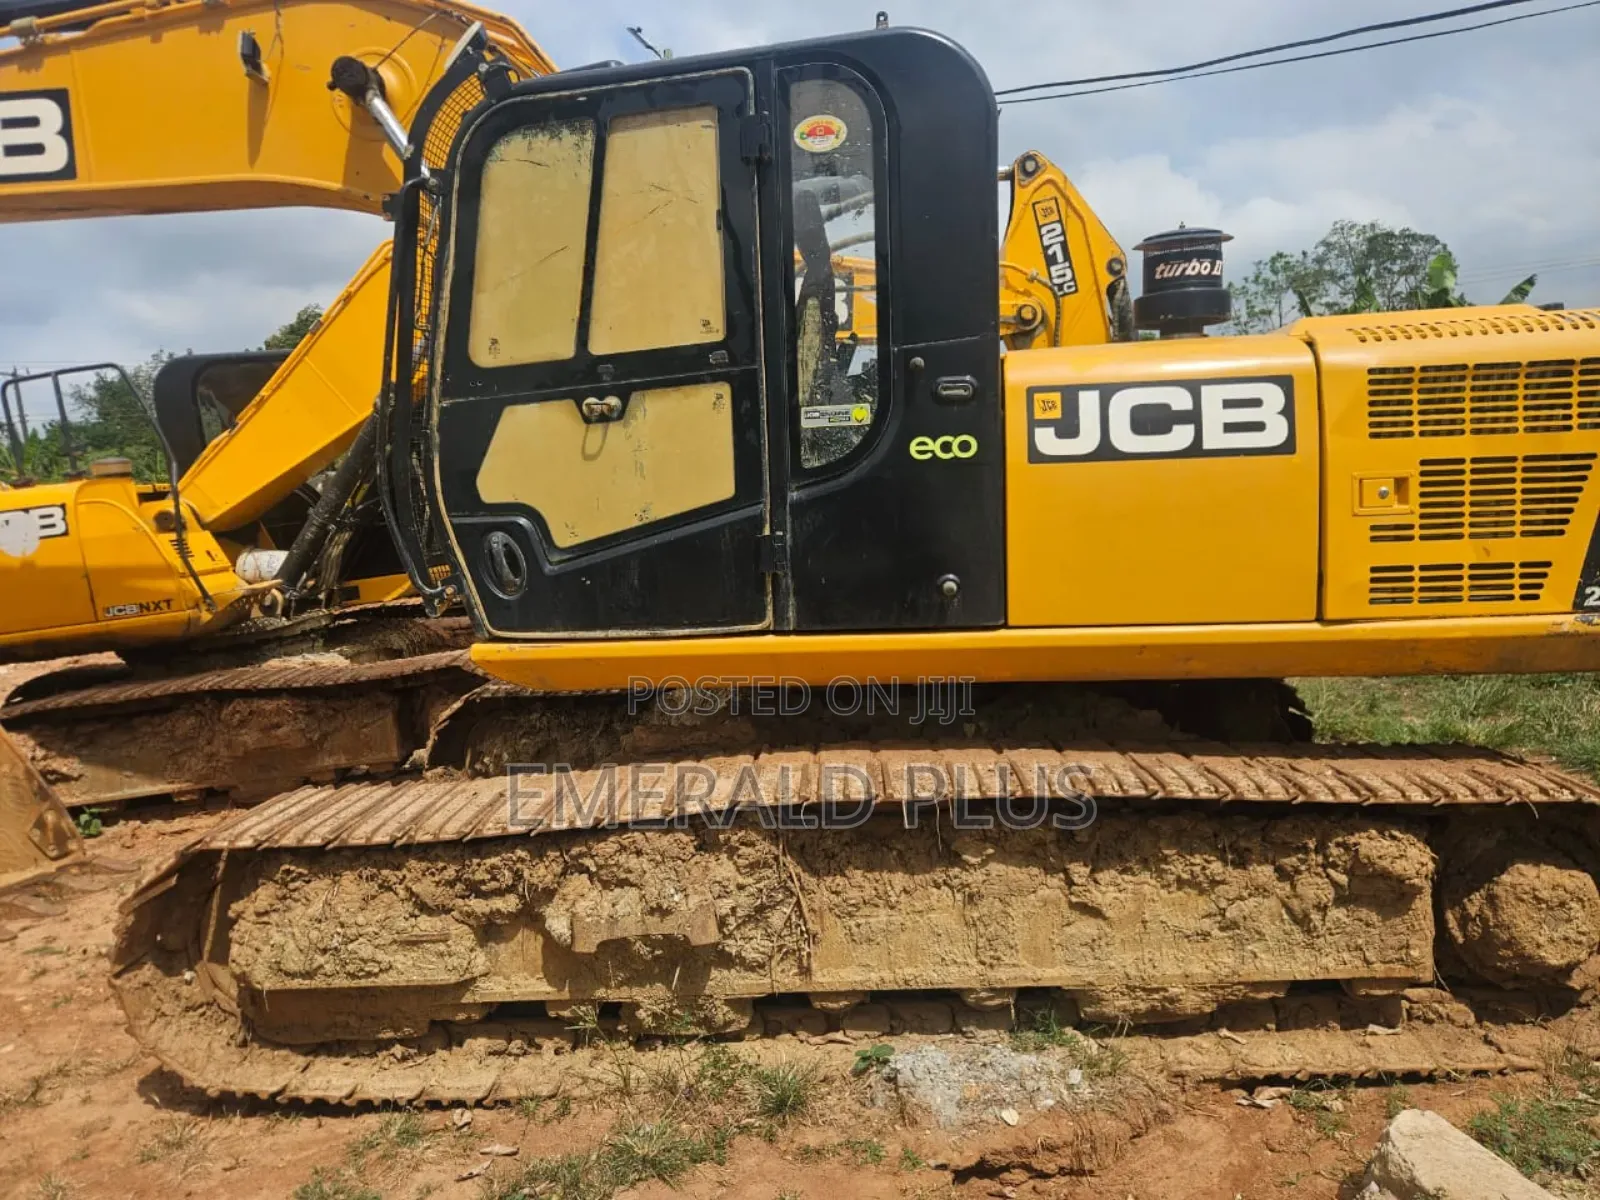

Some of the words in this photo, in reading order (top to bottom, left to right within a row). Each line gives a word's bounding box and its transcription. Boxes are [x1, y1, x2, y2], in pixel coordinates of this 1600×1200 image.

[1155, 258, 1211, 280] turbo
[1034, 382, 1289, 456] JCB
[909, 434, 978, 460] eco
